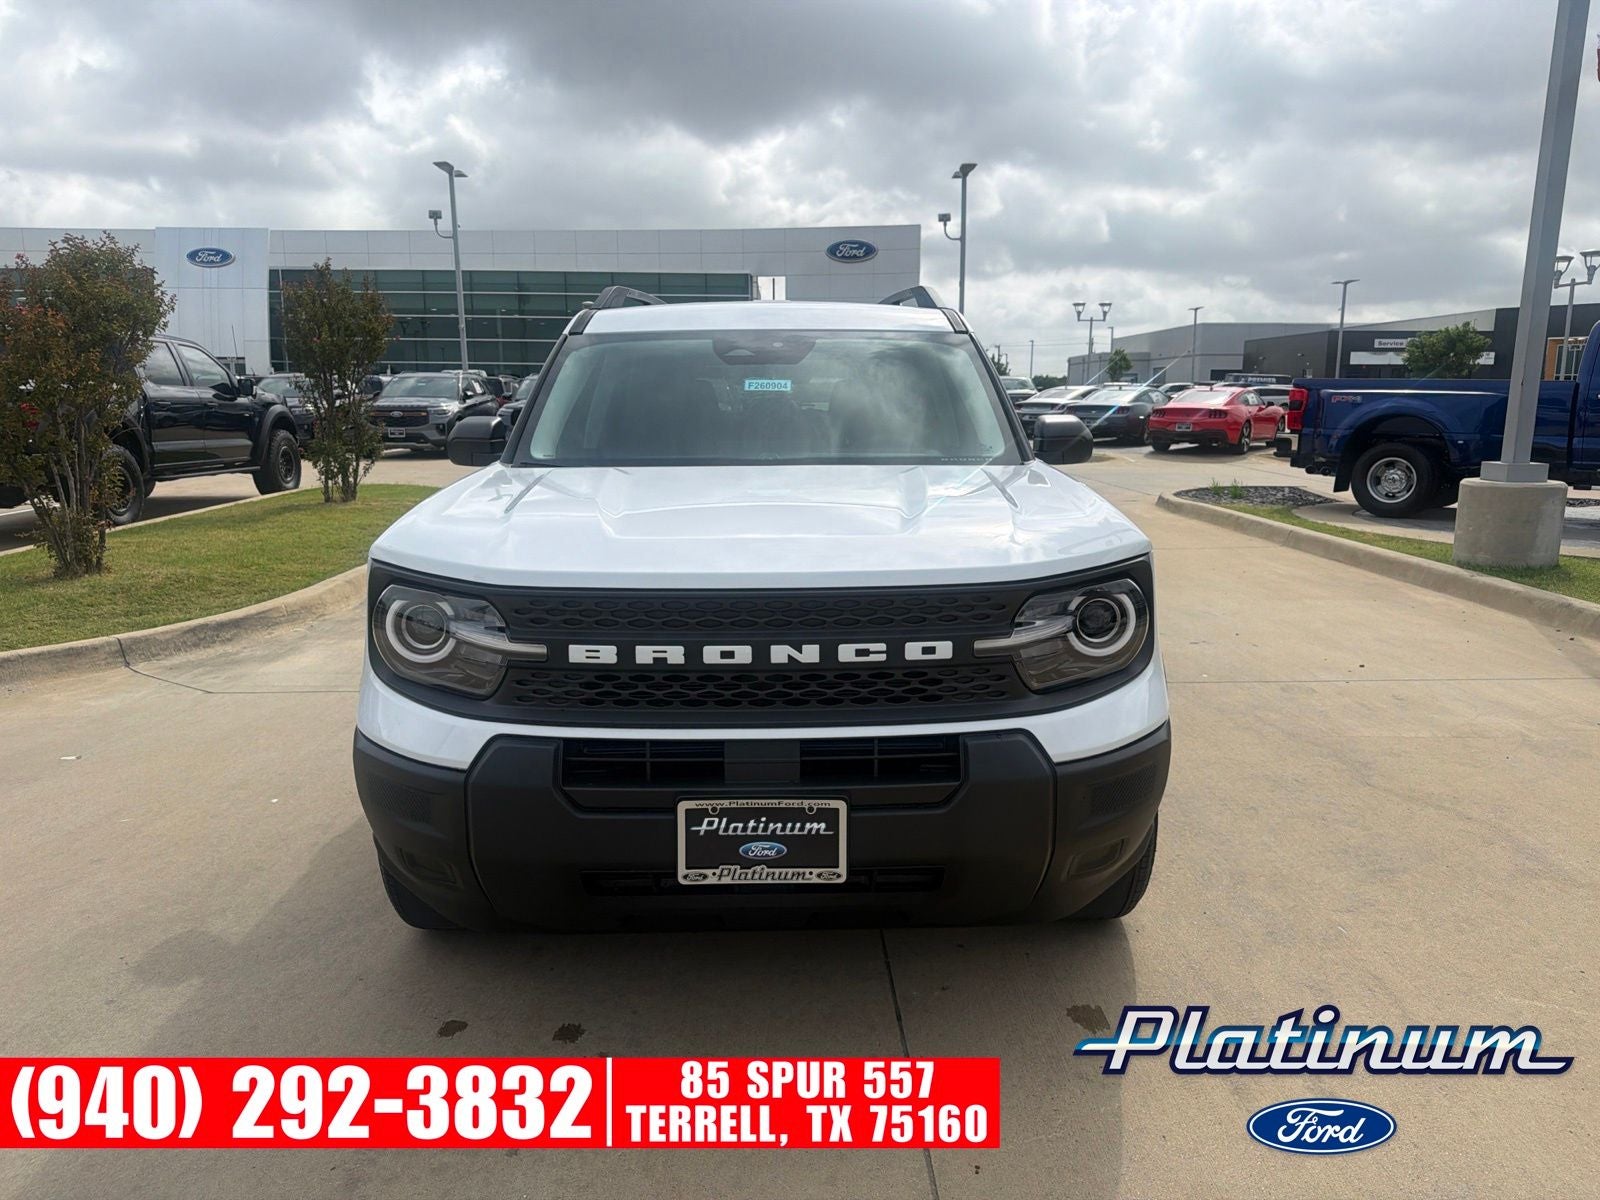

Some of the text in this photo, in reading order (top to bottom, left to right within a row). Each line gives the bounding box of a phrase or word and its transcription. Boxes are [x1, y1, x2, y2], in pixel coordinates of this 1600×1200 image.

[195, 250, 223, 262] Ford
[836, 244, 866, 257] Ford
[747, 381, 788, 390] F260904
[568, 640, 953, 665] BRONCO
[690, 816, 834, 836] Platinum
[748, 843, 778, 857] Ford
[717, 866, 813, 881] Platinum
